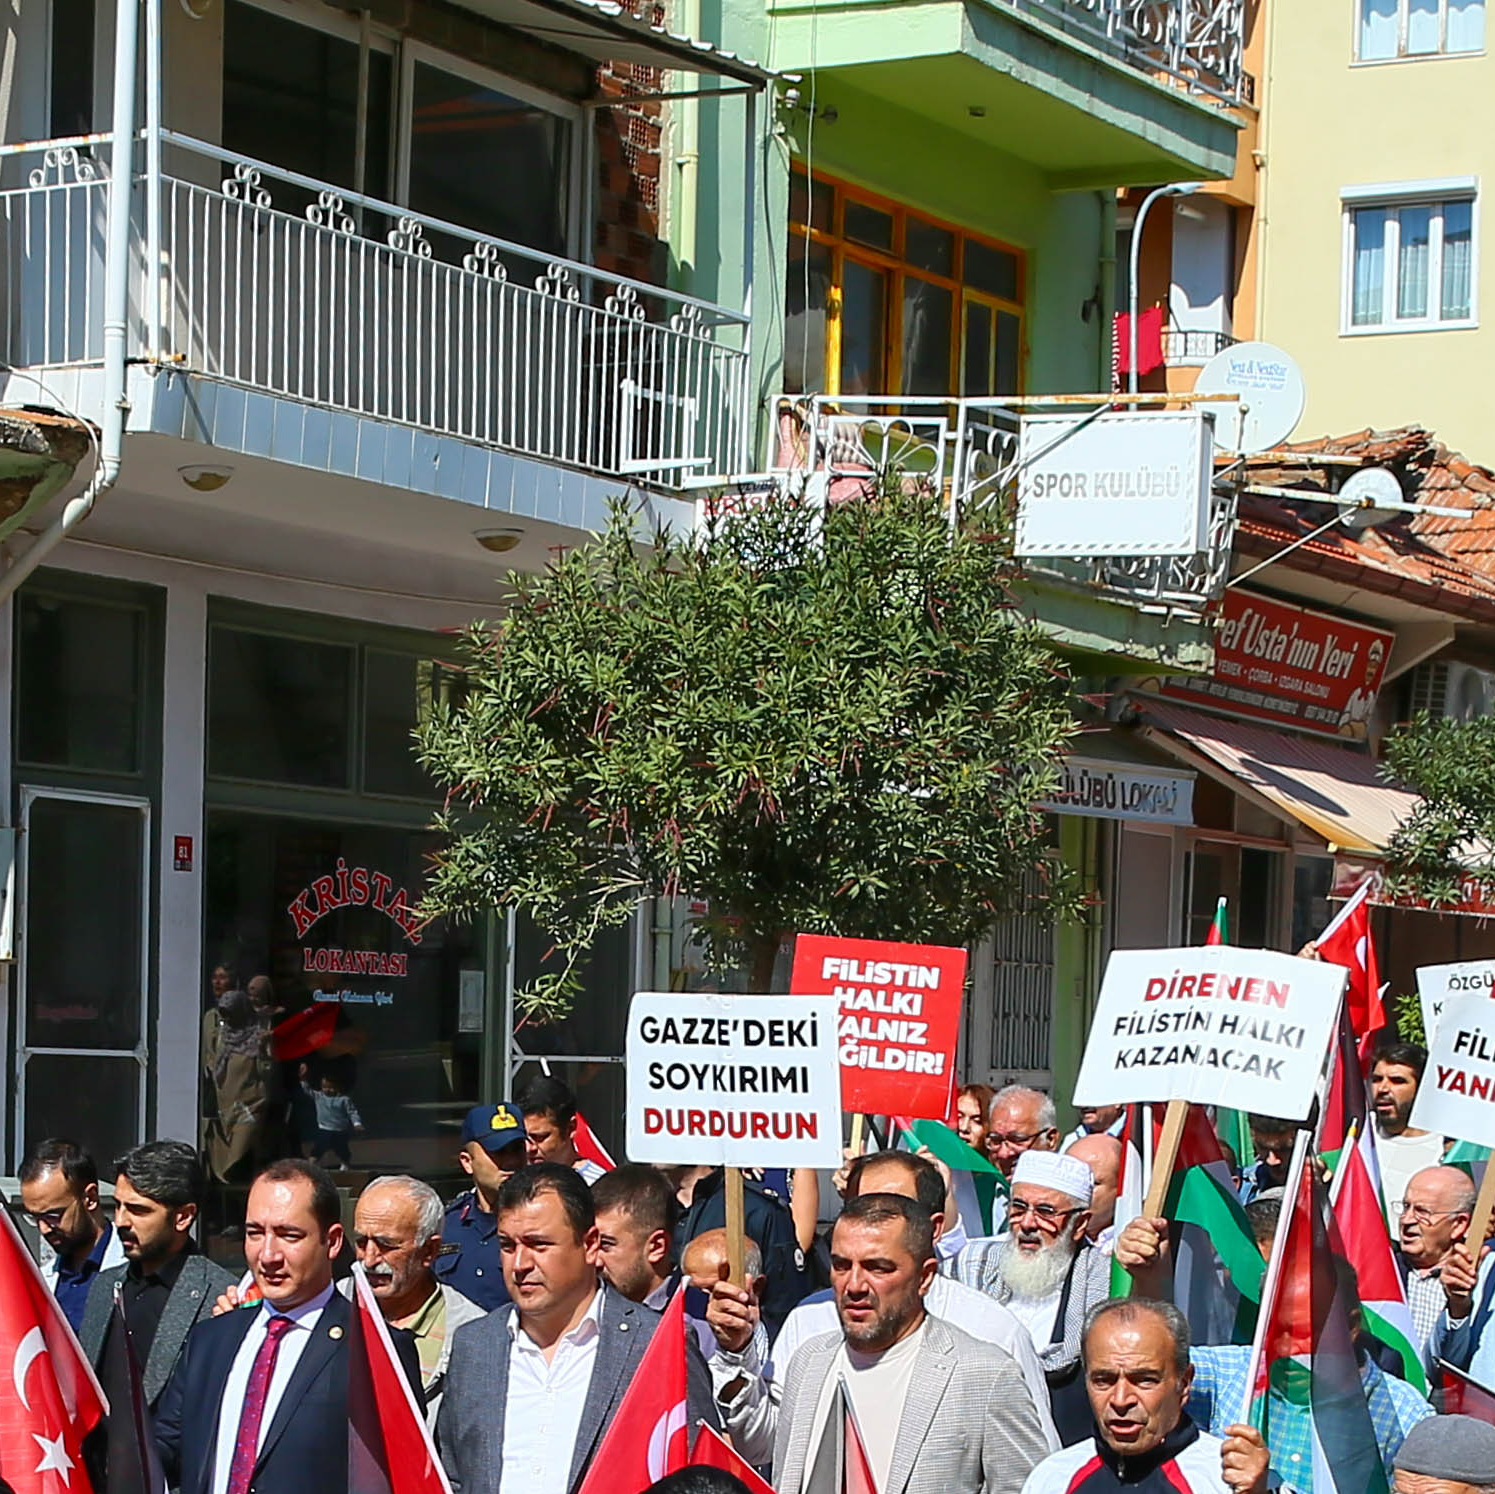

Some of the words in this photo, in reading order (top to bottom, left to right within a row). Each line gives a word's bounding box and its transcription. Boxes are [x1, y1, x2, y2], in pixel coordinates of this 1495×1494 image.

[1032, 473, 1088, 499] SPOR
[1093, 466, 1180, 498] KULÜBÜ
[1317, 633, 1359, 680] Yeri
[303, 947, 408, 977] LOKANTASI
[821, 956, 940, 990] FİLİSTİN
[1143, 968, 1291, 1010] DİRENEN
[1448, 972, 1494, 991] ÖZGÜ
[833, 985, 923, 1016] HALKI
[640, 1012, 819, 1048] GAZZE'DEKİ
[1112, 1005, 1212, 1036] FİLİSTİN
[1218, 1015, 1306, 1049] HALKI
[839, 1037, 947, 1076] ĞİLDİR!
[1113, 1044, 1286, 1081] KAZANACAK
[648, 1062, 810, 1094] SOYKIRIMI
[644, 1108, 818, 1140] DURDURUN
